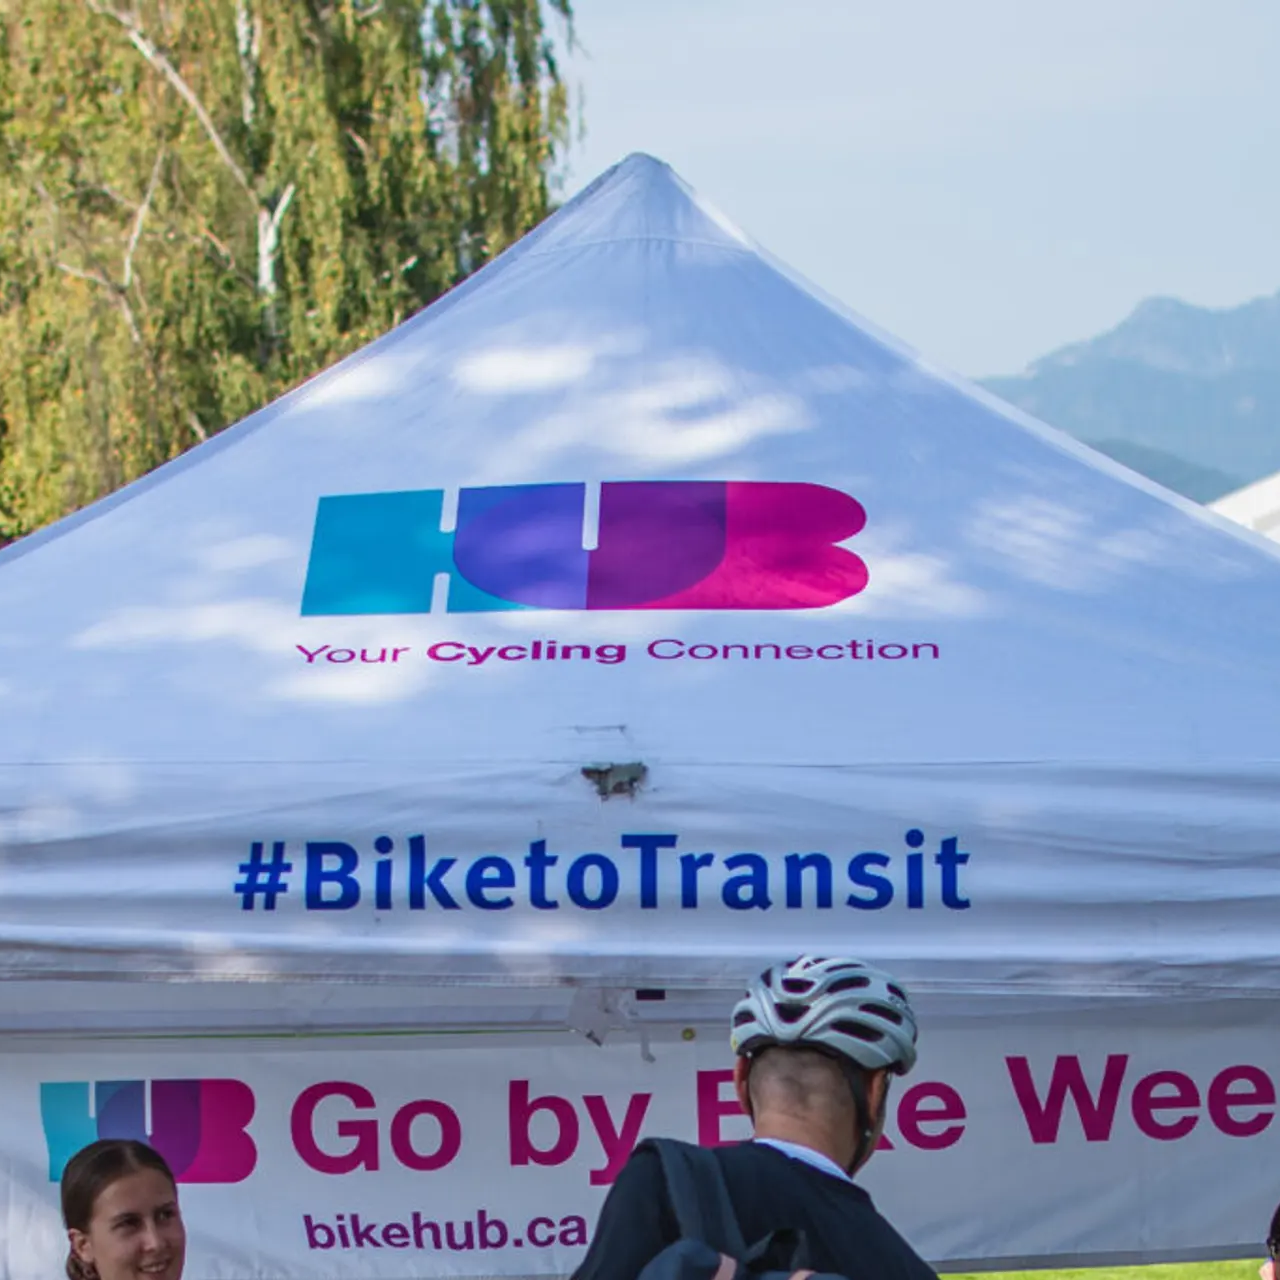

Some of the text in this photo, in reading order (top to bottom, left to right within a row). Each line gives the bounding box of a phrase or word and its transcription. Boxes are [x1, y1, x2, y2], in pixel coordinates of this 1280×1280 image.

[301, 480, 869, 616] HUB
[295, 638, 940, 665] Your Cycling Connection
[233, 828, 971, 912] #BiketoTransit
[290, 1080, 462, 1175] Go
[508, 1079, 652, 1186] by
[303, 1210, 588, 1250] bikehub.ca
